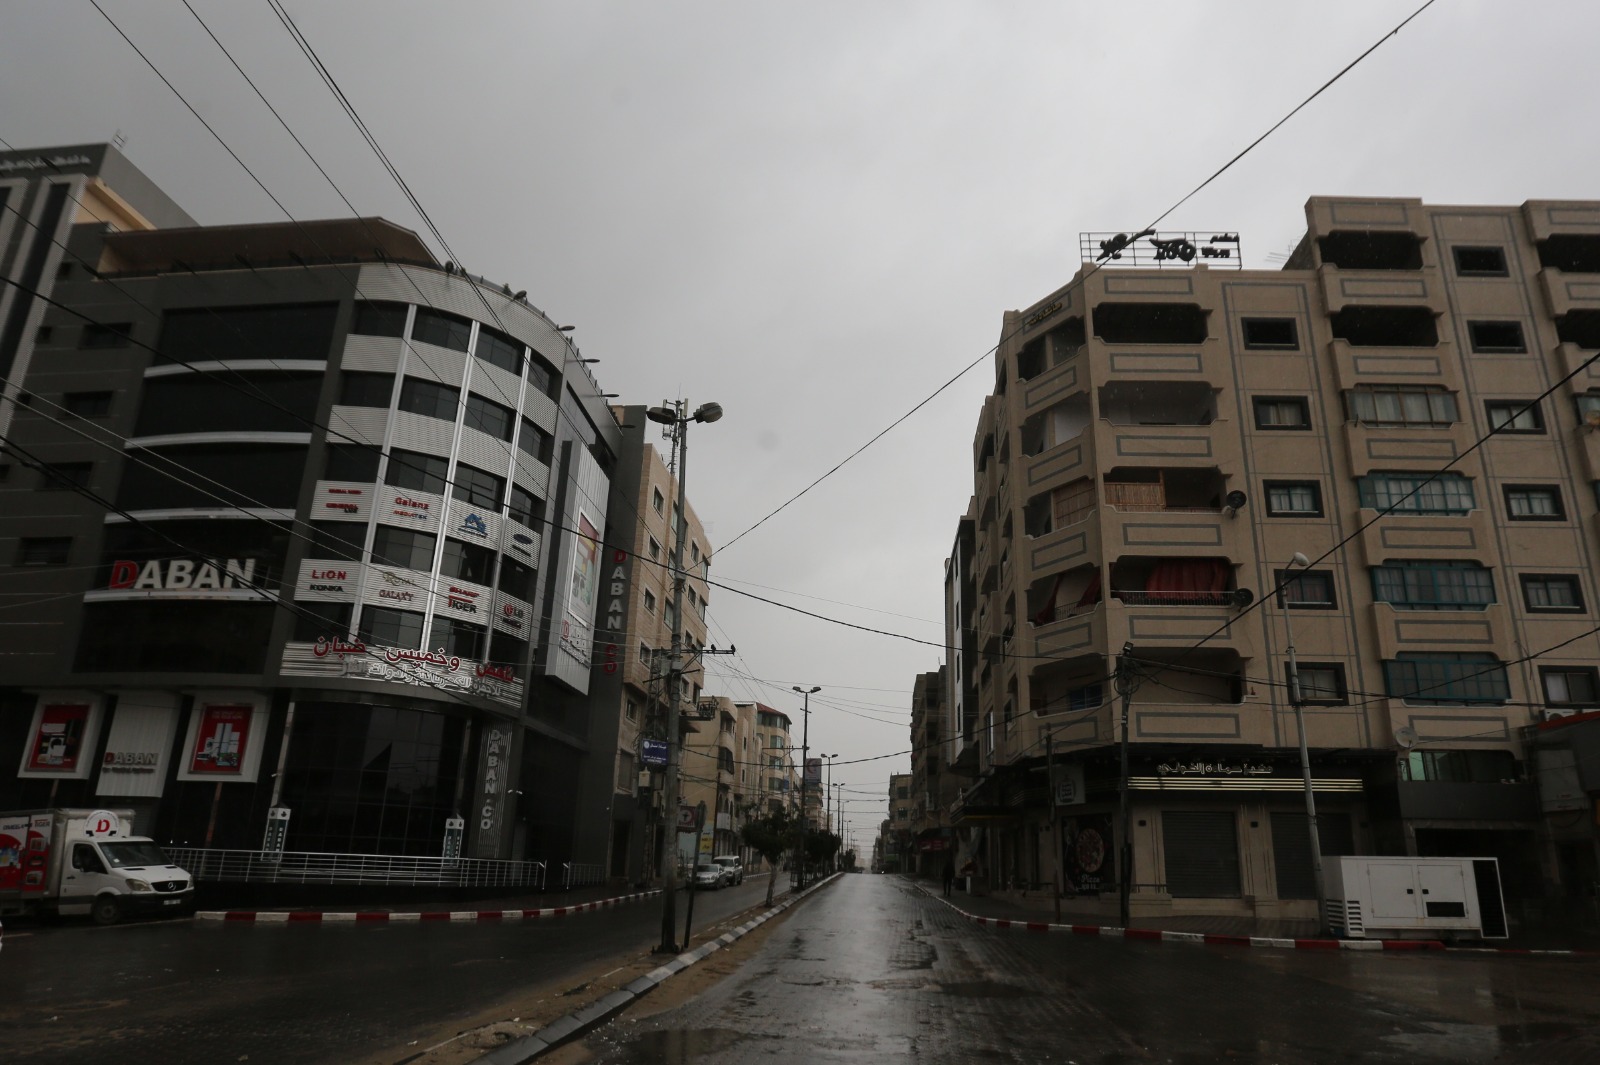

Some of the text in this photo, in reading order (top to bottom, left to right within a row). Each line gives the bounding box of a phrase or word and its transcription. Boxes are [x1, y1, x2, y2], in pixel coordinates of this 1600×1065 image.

[109, 559, 256, 589] DABAN
[448, 595, 477, 613] TIGER
[313, 636, 367, 660] ضبان
[385, 647, 461, 672] وخميس
[104, 752, 159, 765] DABAN
